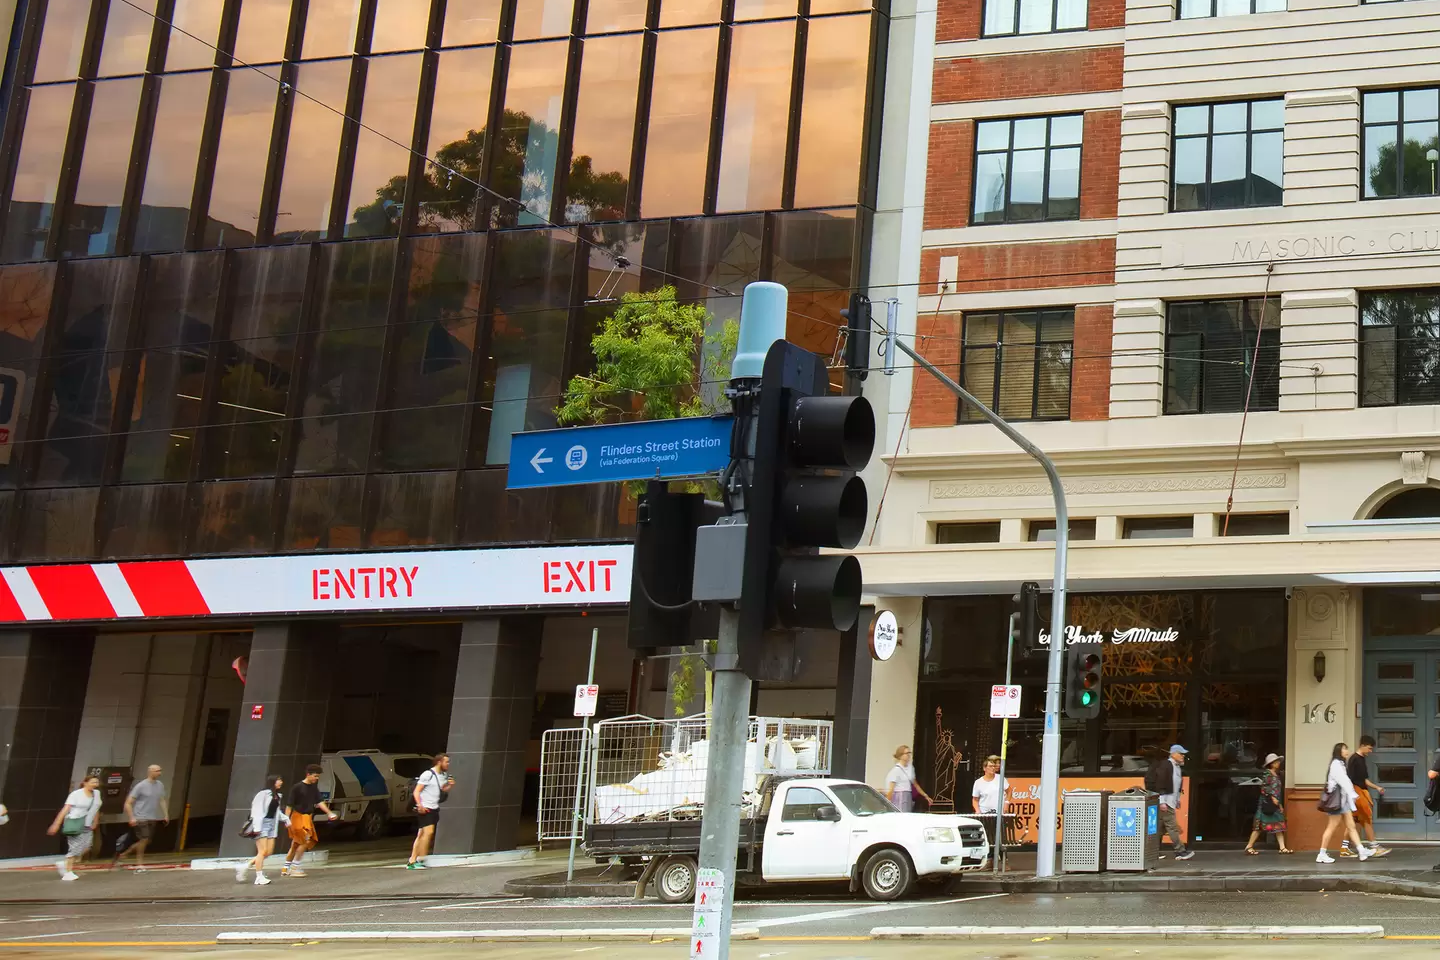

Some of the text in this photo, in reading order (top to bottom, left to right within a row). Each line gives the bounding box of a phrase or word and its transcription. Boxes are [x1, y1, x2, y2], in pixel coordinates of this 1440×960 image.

[1231, 235, 1356, 262] MASONIC
[600, 437, 721, 457] Flinders Street Station
[599, 452, 679, 468] (via Federation Square)
[312, 566, 419, 600] ENTRY
[543, 559, 617, 593] EXIT
[1064, 625, 1104, 645] York
[1111, 626, 1179, 645] Minute
[1008, 802, 1036, 815] OTED
